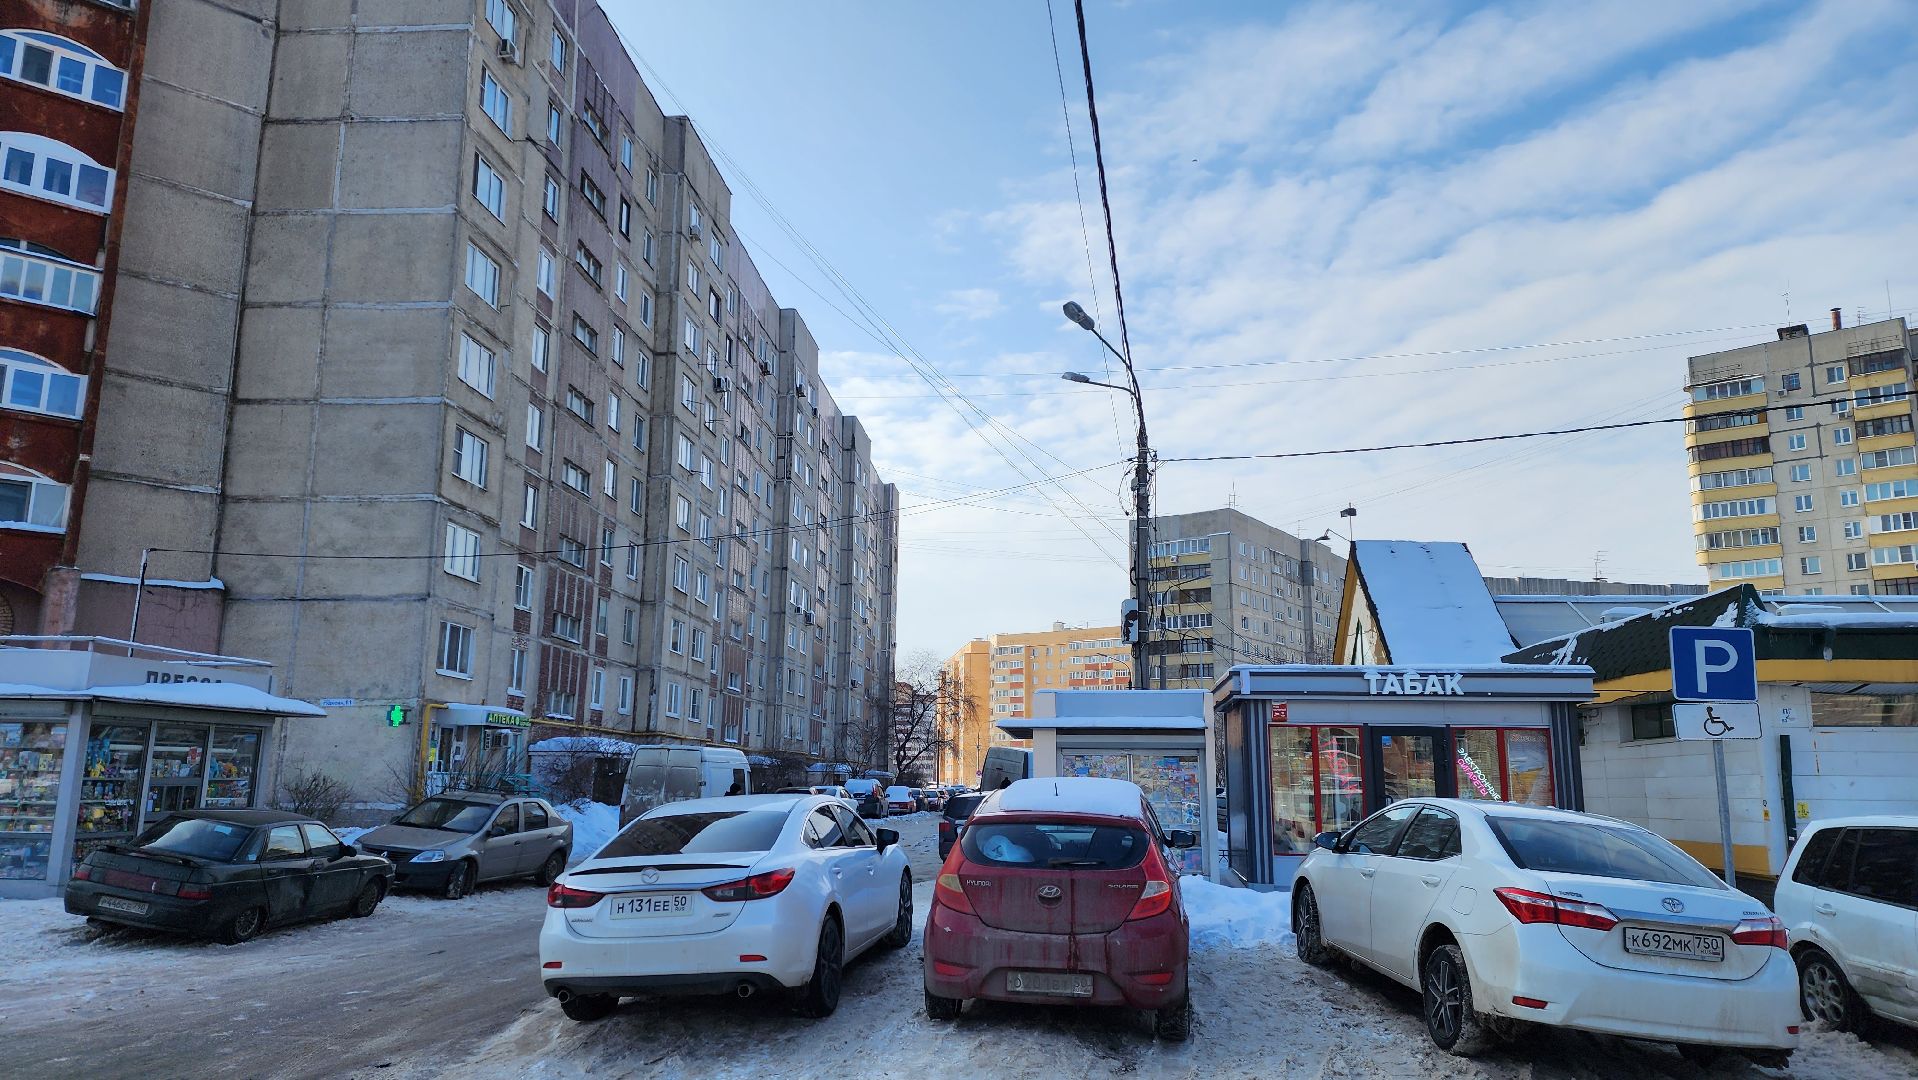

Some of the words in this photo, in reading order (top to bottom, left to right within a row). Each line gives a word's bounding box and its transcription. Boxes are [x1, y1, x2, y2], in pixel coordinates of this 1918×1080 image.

[1694, 640, 1739, 693] P
[1363, 672, 1465, 695] ТАБАК
[488, 712, 515, 725] АПТЕКА
[1457, 747, 1501, 801] ЭЛЕКТРОННЫЕ
[1457, 758, 1488, 797] СИГАРЕТЫ
[966, 879, 992, 887] HYUNDAI
[673, 896, 687, 906] 50
[1558, 890, 1583, 898] TOYOTA
[1631, 932, 1692, 952] К692МК
[1694, 936, 1719, 950] 750
